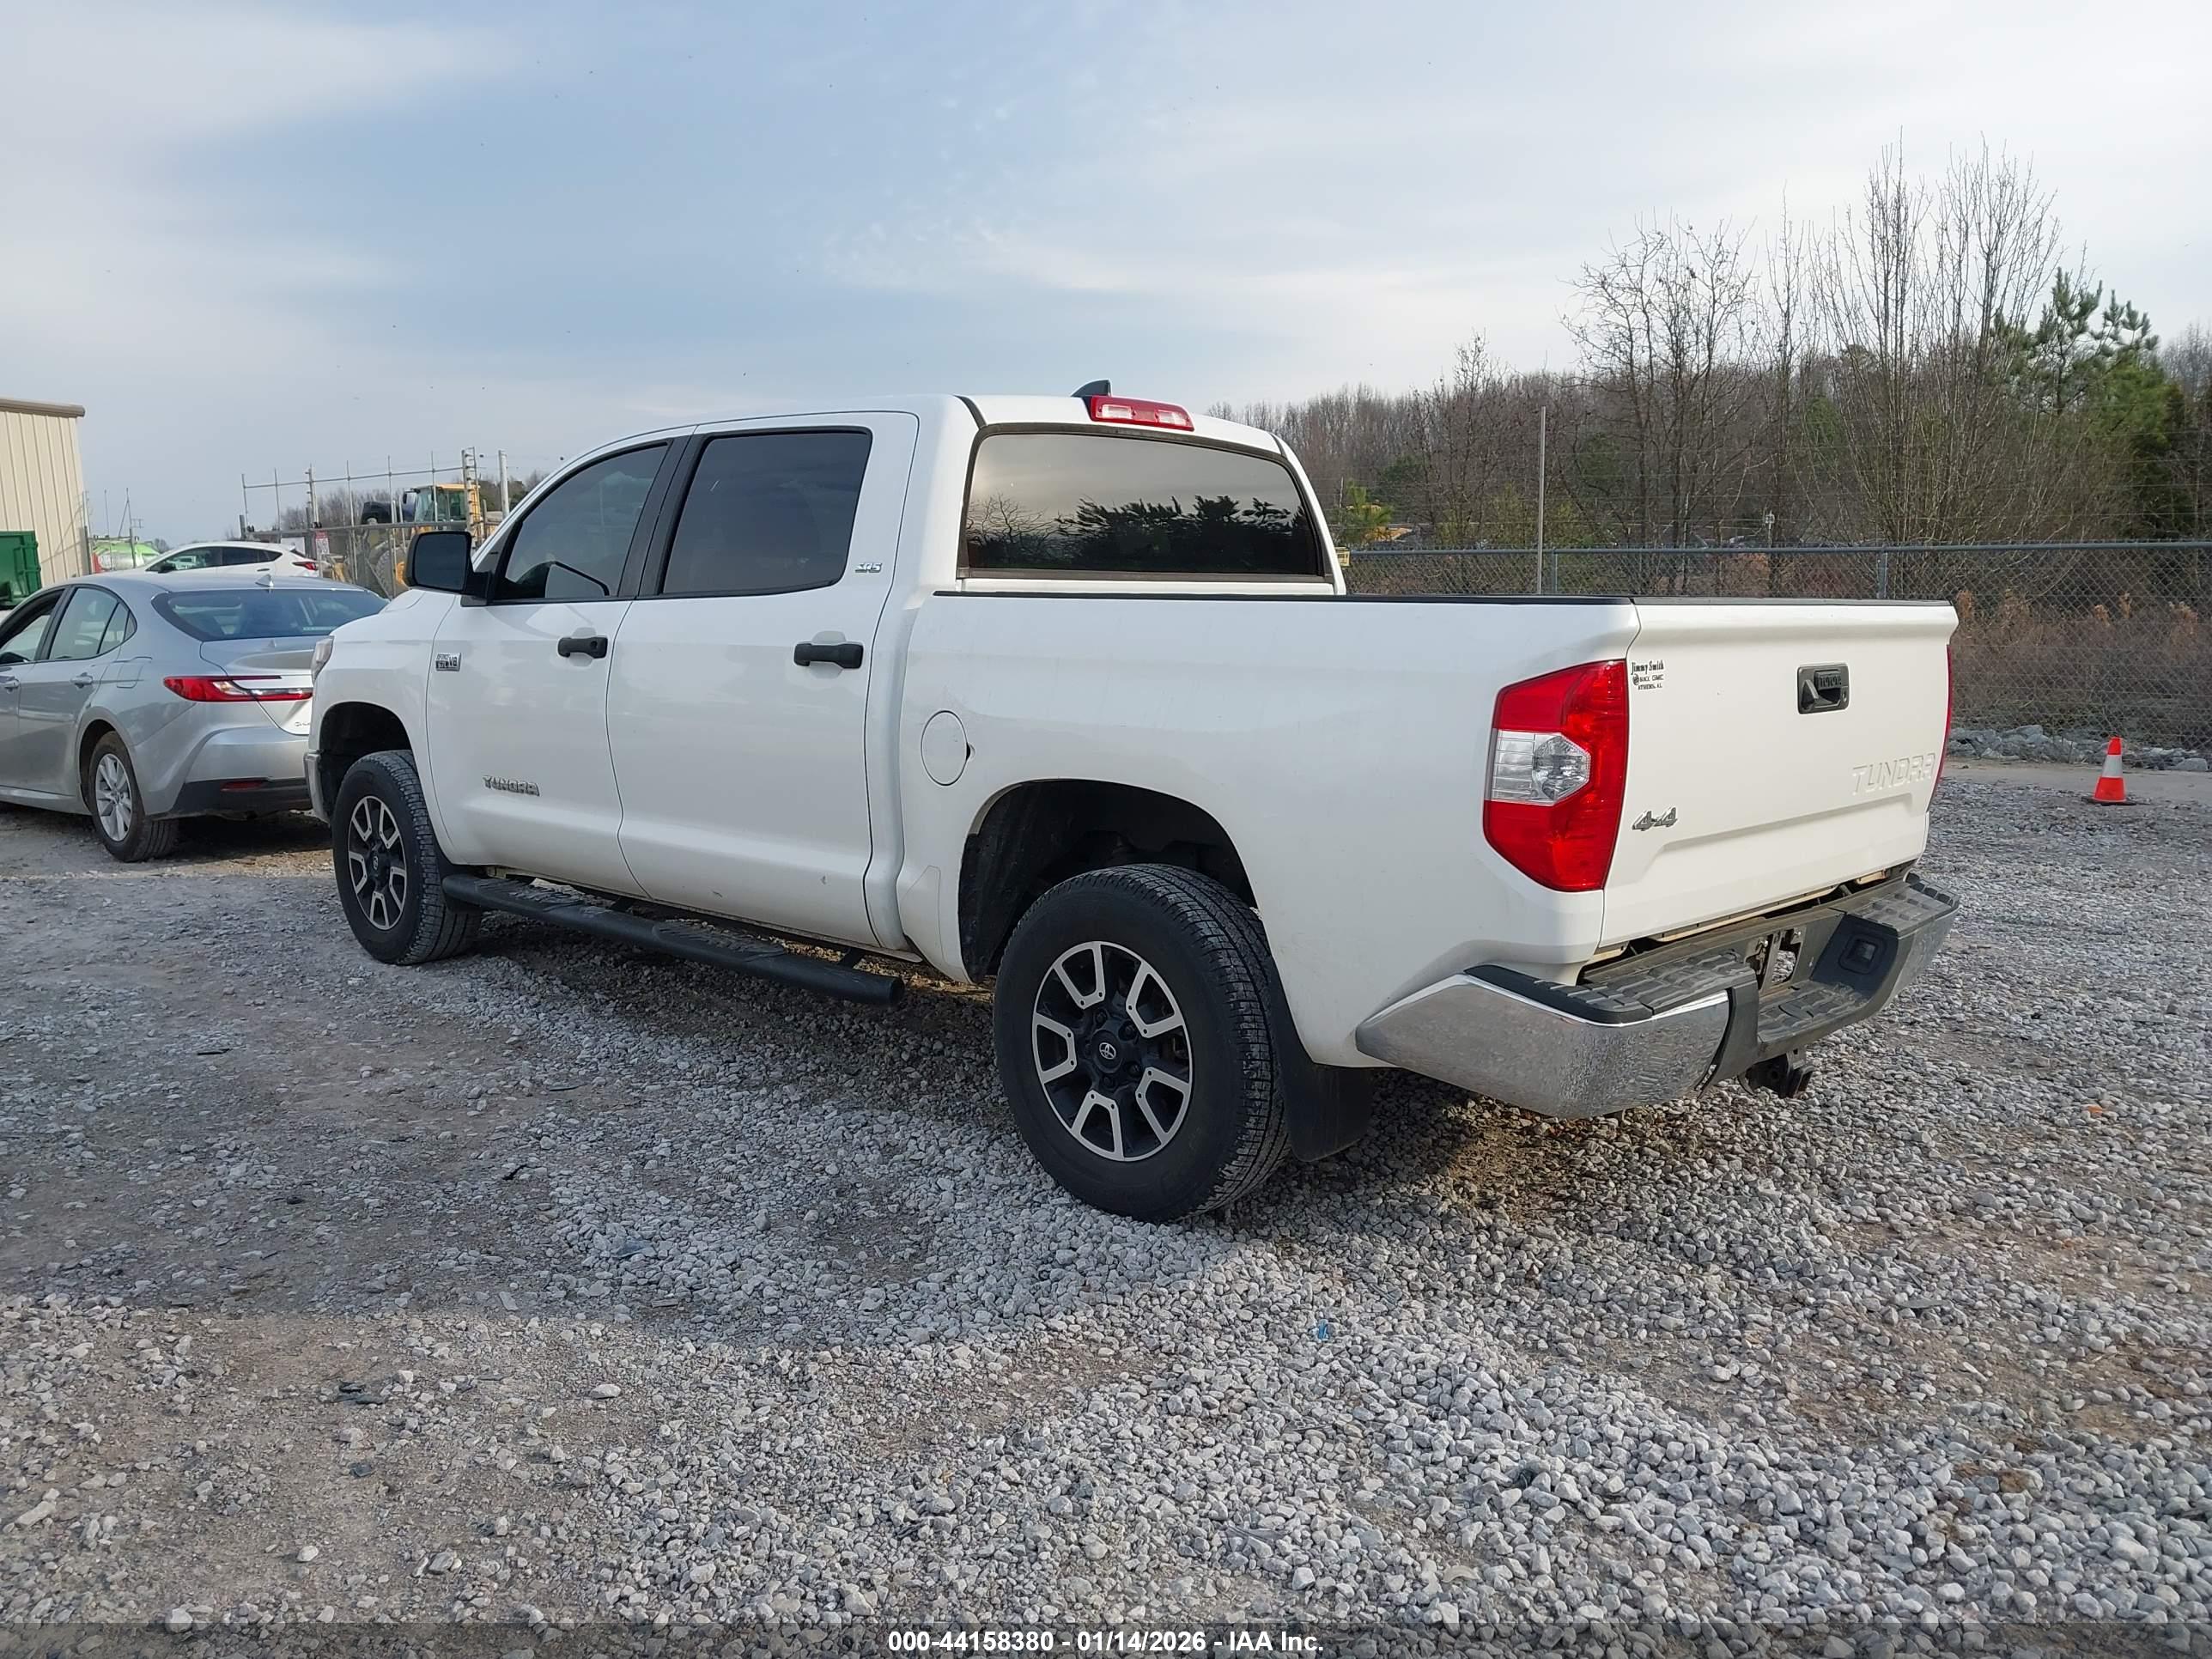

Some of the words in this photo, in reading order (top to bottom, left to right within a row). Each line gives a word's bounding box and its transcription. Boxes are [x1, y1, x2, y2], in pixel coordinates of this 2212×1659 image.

[1631, 662, 1648, 675] Jimmy
[1648, 659, 1664, 671] Smith
[1851, 753, 1936, 796] TUNDRA
[483, 775, 541, 797] TUNDRA
